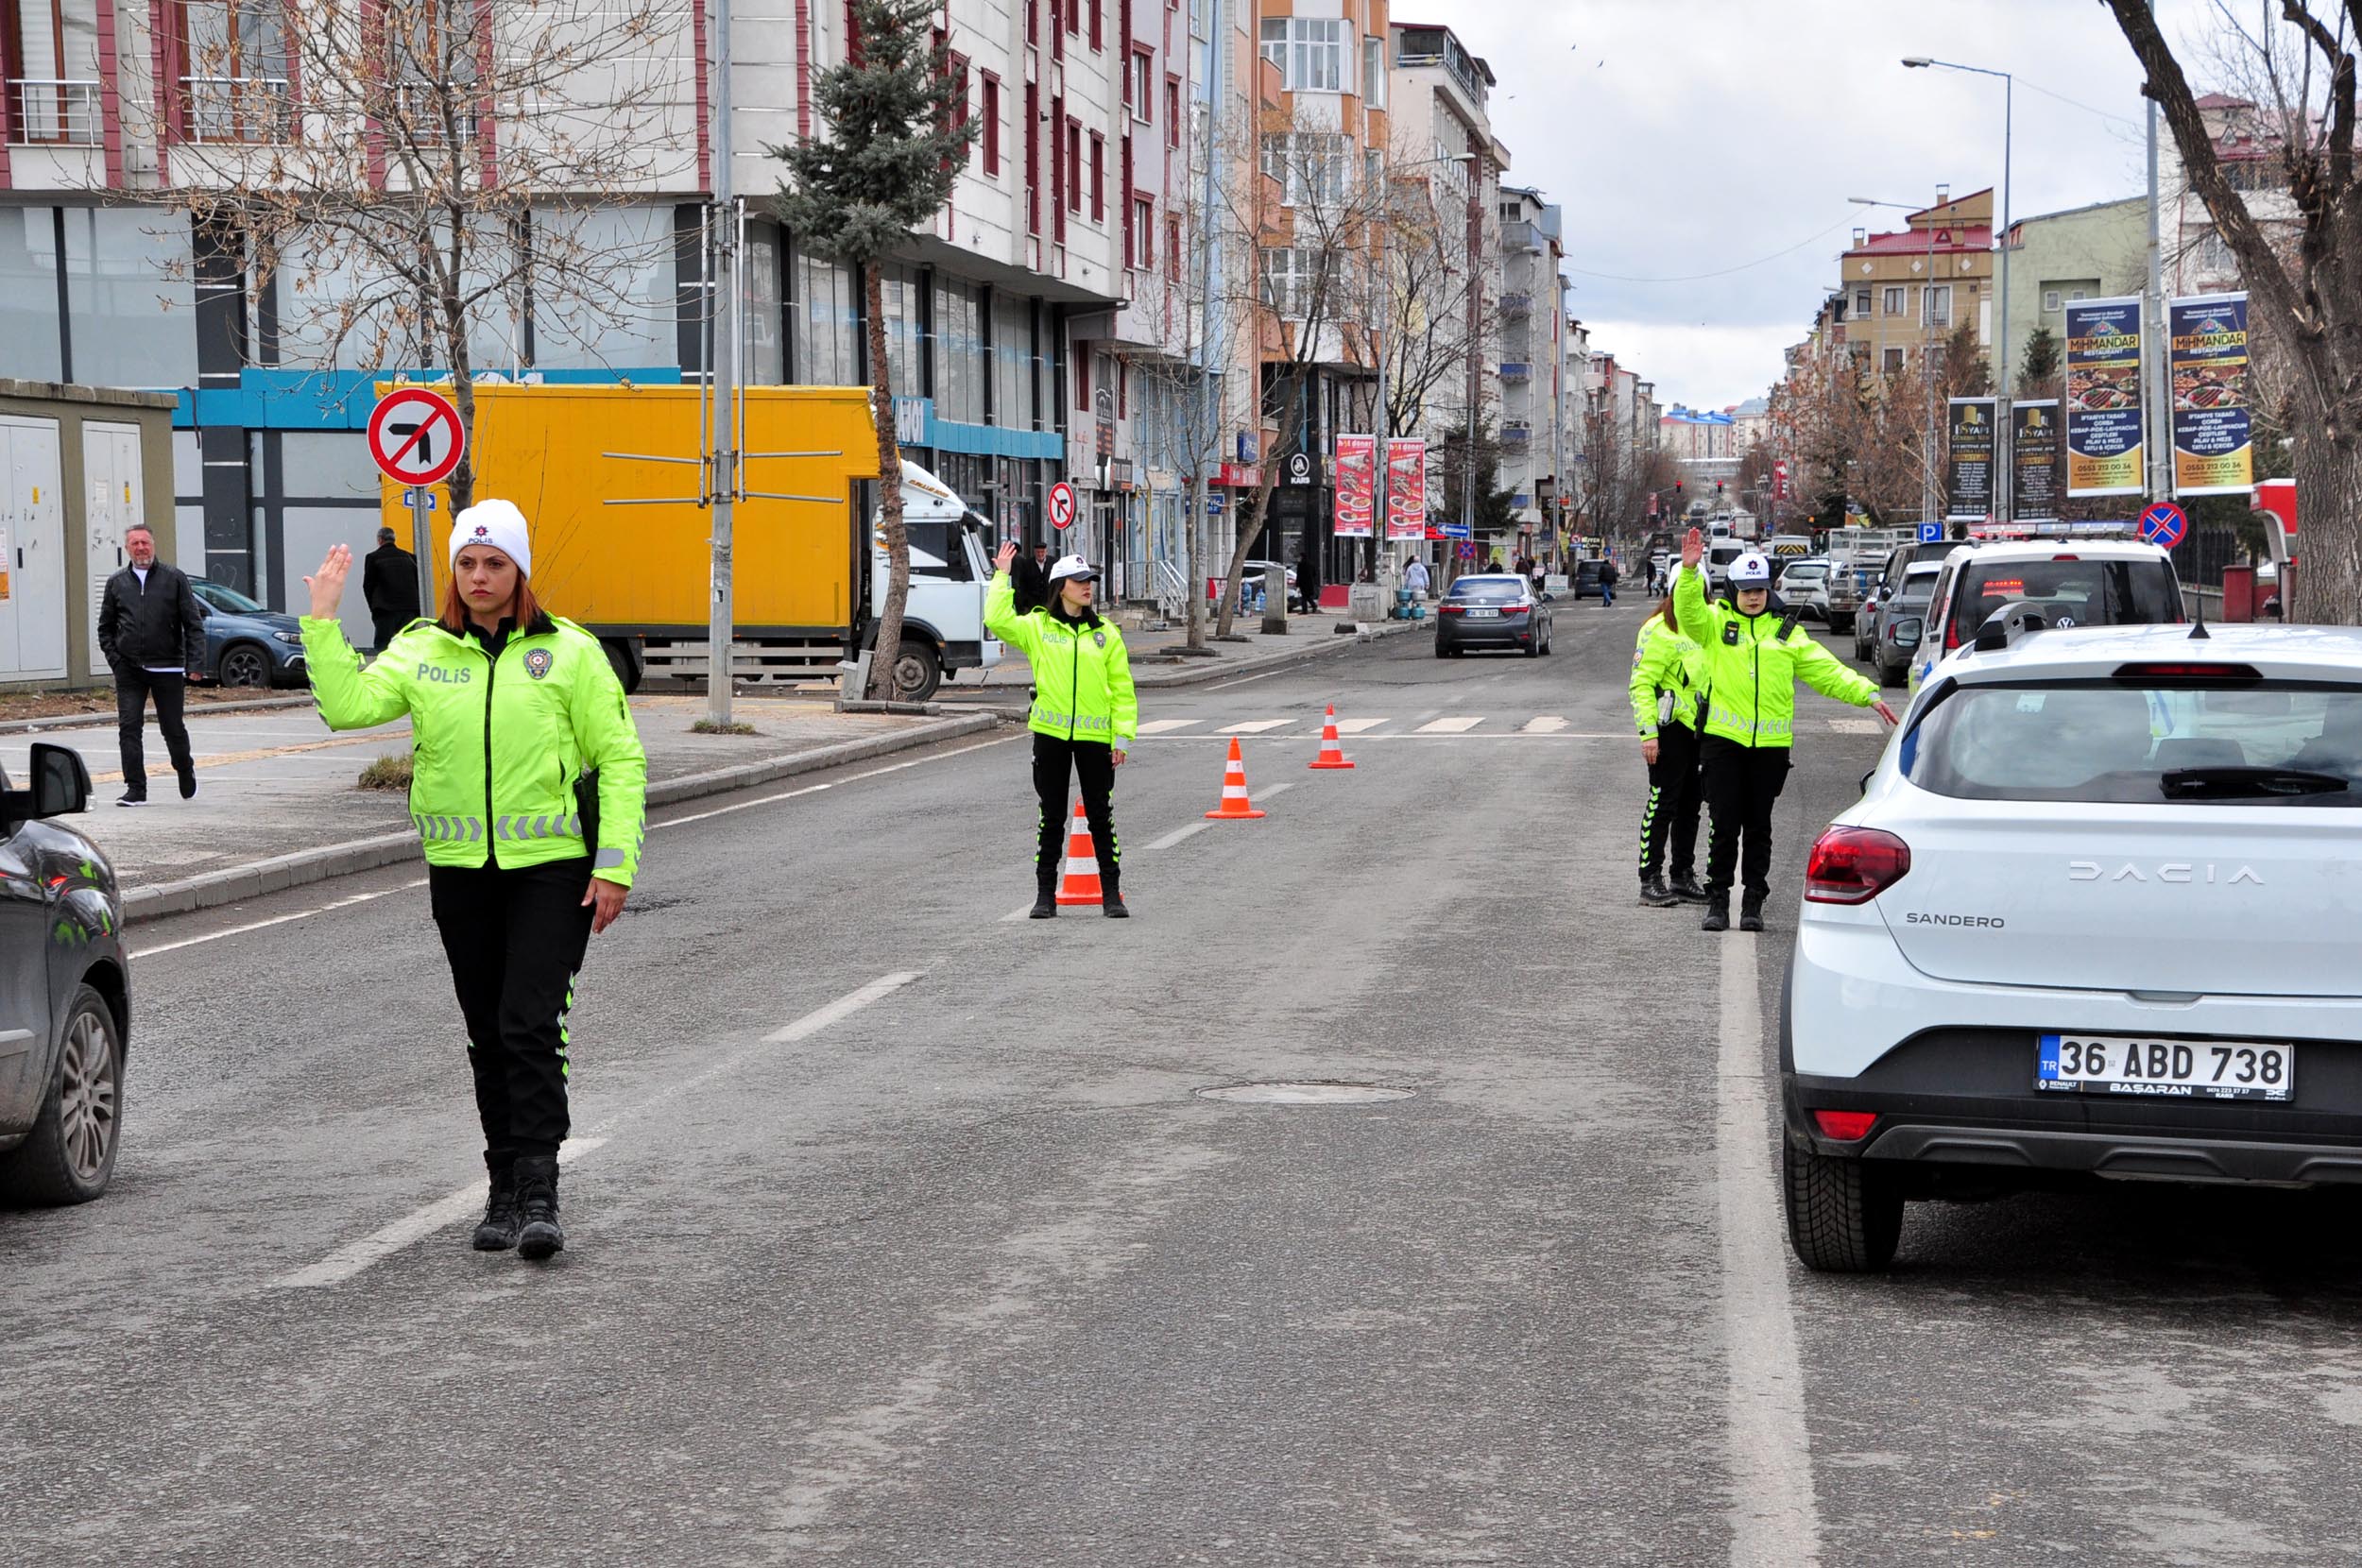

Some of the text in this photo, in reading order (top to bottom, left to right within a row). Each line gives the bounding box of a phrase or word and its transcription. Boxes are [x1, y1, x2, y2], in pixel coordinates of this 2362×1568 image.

[2083, 349, 2124, 357] RESTAURANT
[2189, 346, 2231, 355] RESTAURANT
[2069, 861, 2266, 885] DACIA
[1907, 912, 2005, 929] SANDERO
[2042, 1061, 2058, 1071] TR
[2062, 1041, 2282, 1084] 36 ABD 738
[2110, 1082, 2192, 1096] BAŞARAN
